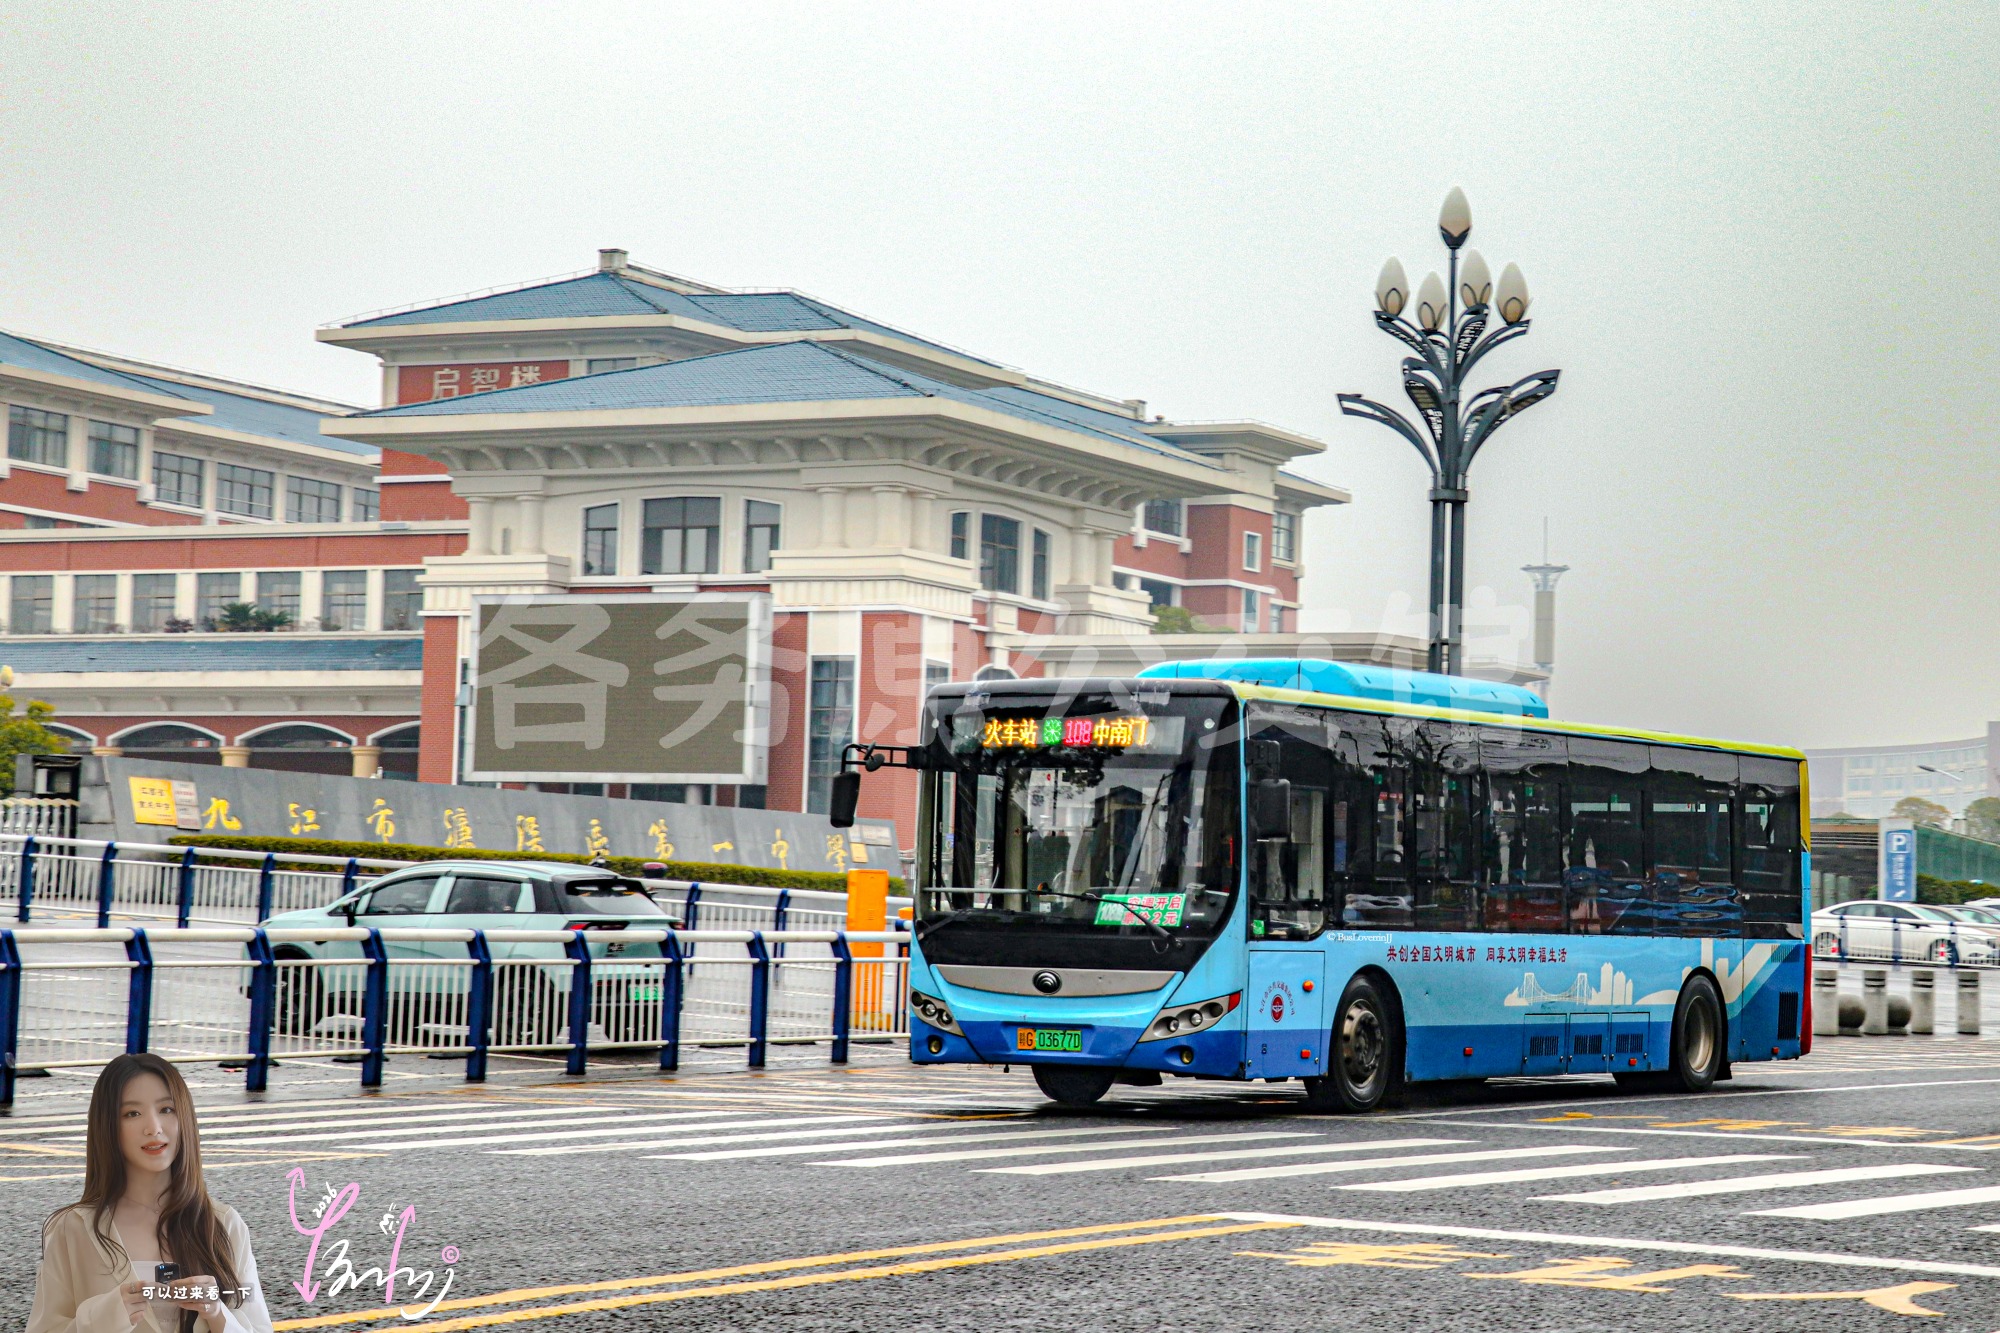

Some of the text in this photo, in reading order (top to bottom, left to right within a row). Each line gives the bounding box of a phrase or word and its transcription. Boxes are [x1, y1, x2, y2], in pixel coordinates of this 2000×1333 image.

[432, 365, 541, 400] 启智楼
[983, 717, 1149, 747] 火车站 108 中南门
[1893, 835, 1906, 851] P
[1386, 945, 1568, 963] 共创全国文明城市 同享文明幸福生活
